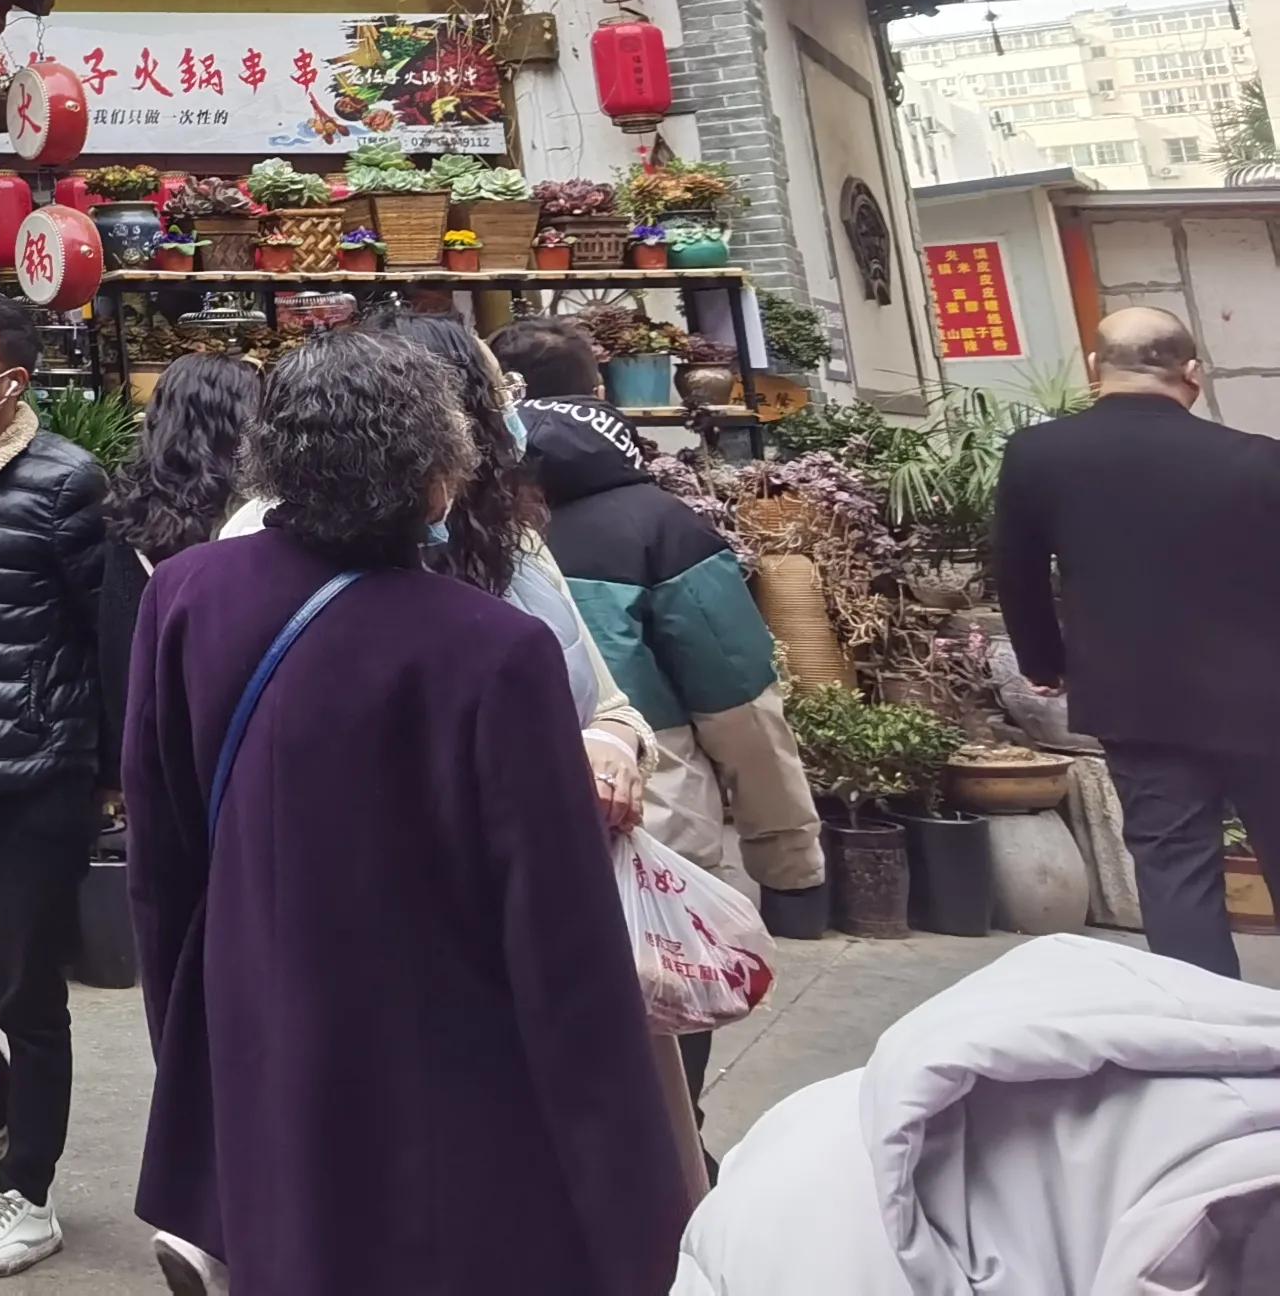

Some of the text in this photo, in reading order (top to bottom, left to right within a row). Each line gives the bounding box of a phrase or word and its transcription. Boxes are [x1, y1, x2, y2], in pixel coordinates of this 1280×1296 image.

[16, 82, 42, 141] 火
[92, 108, 229, 126] 我们只做一次性的
